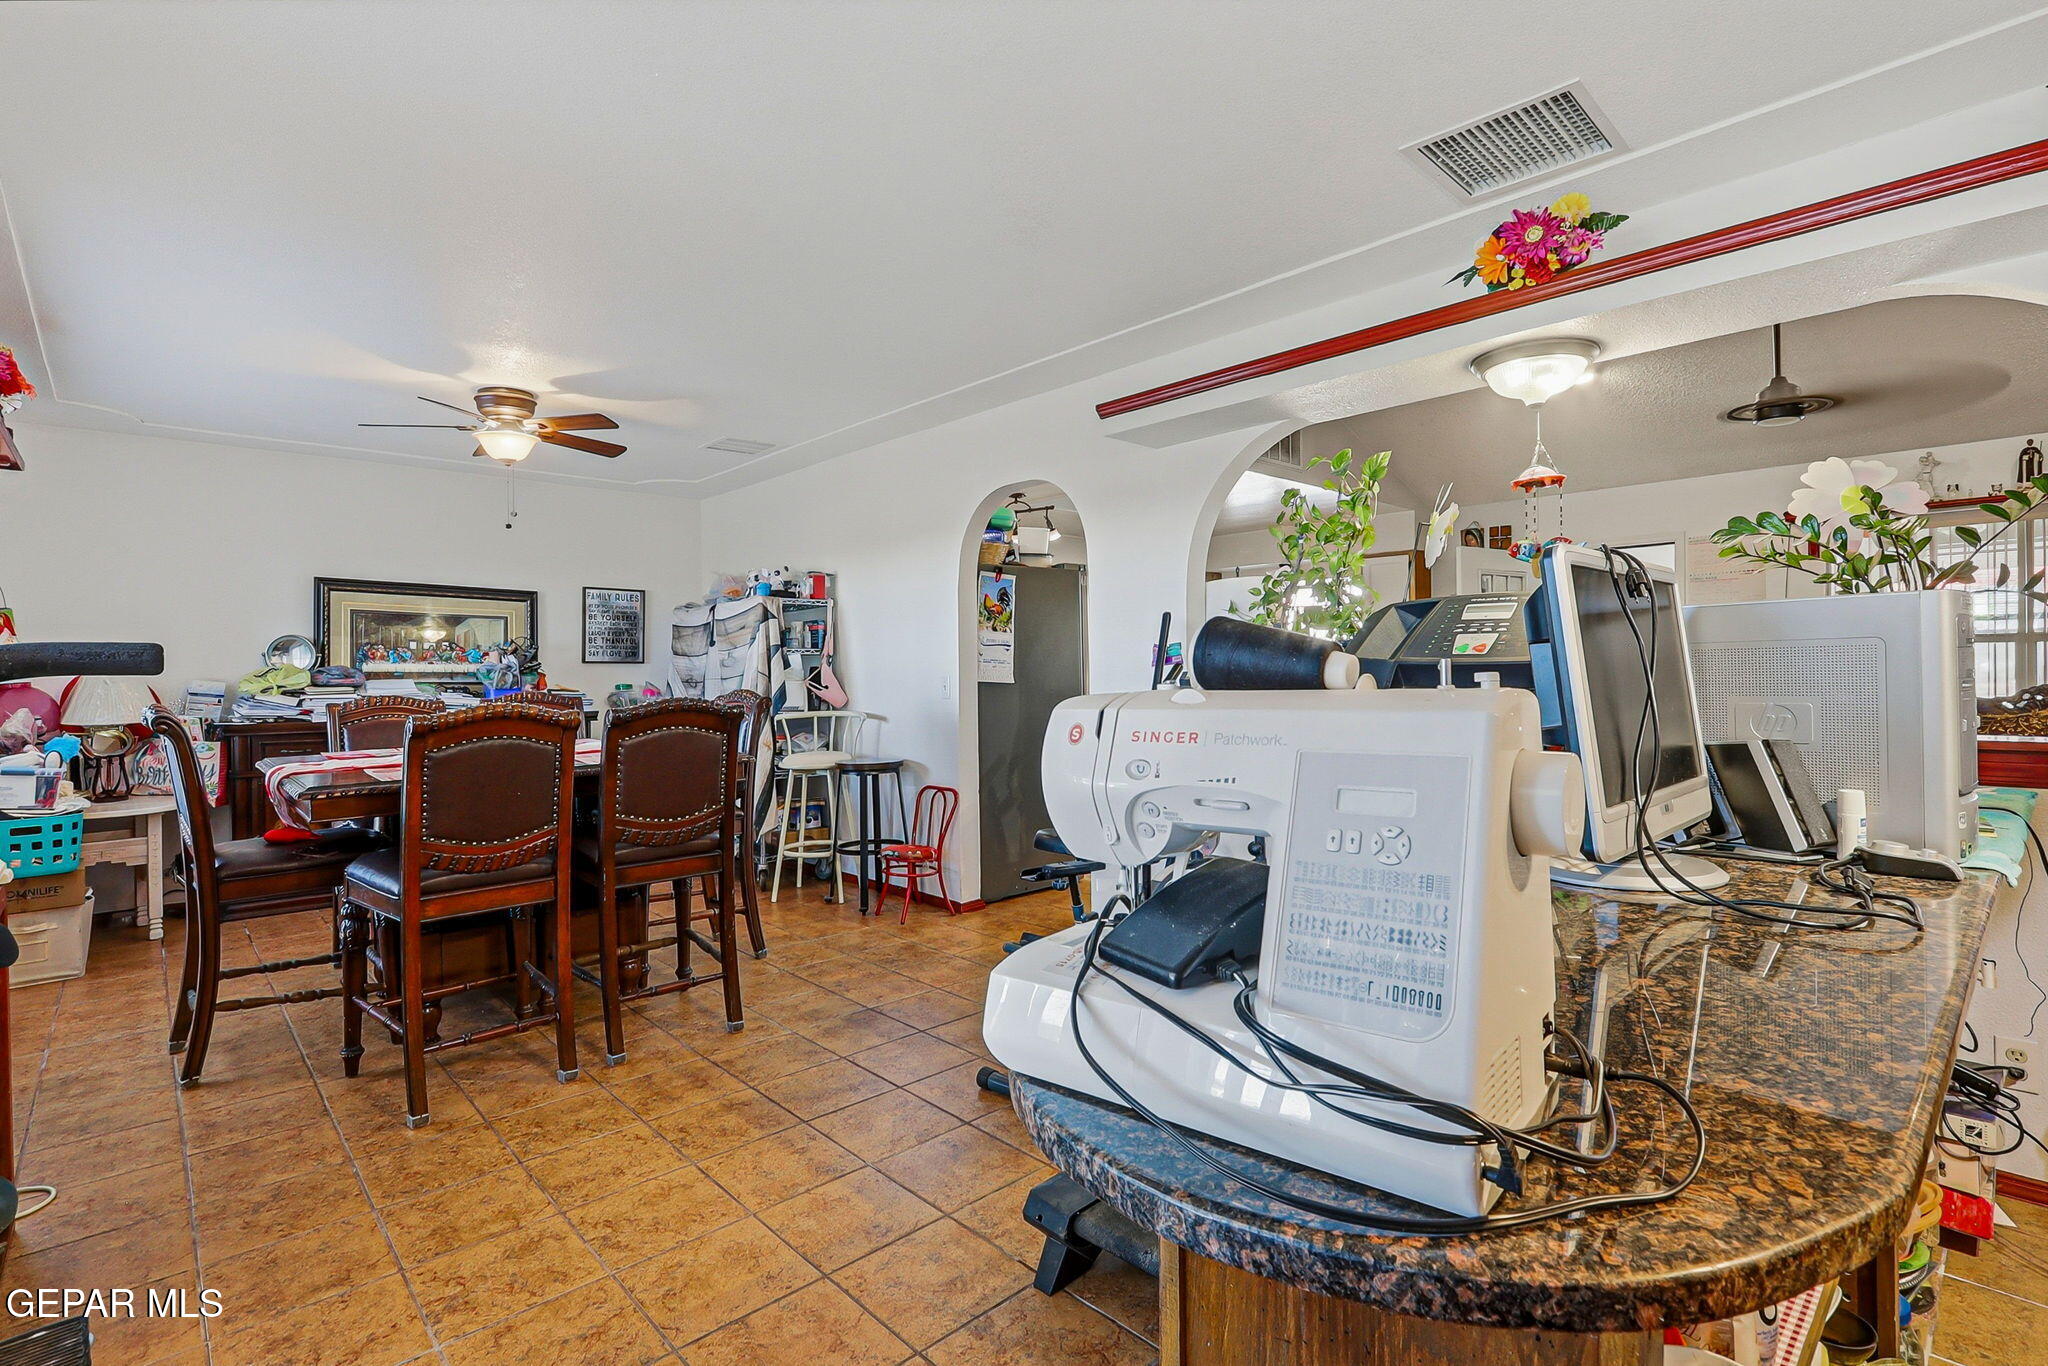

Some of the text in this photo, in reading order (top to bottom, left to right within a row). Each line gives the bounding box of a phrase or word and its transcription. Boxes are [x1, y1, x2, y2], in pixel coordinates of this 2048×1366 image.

[587, 592, 640, 603] FAMILY RULES
[601, 614, 638, 622] YOURSELF
[601, 637, 638, 645] THANKFUL
[1131, 730, 1283, 746] SINGER Patchwork
[7, 885, 60, 899] OMNILIFE
